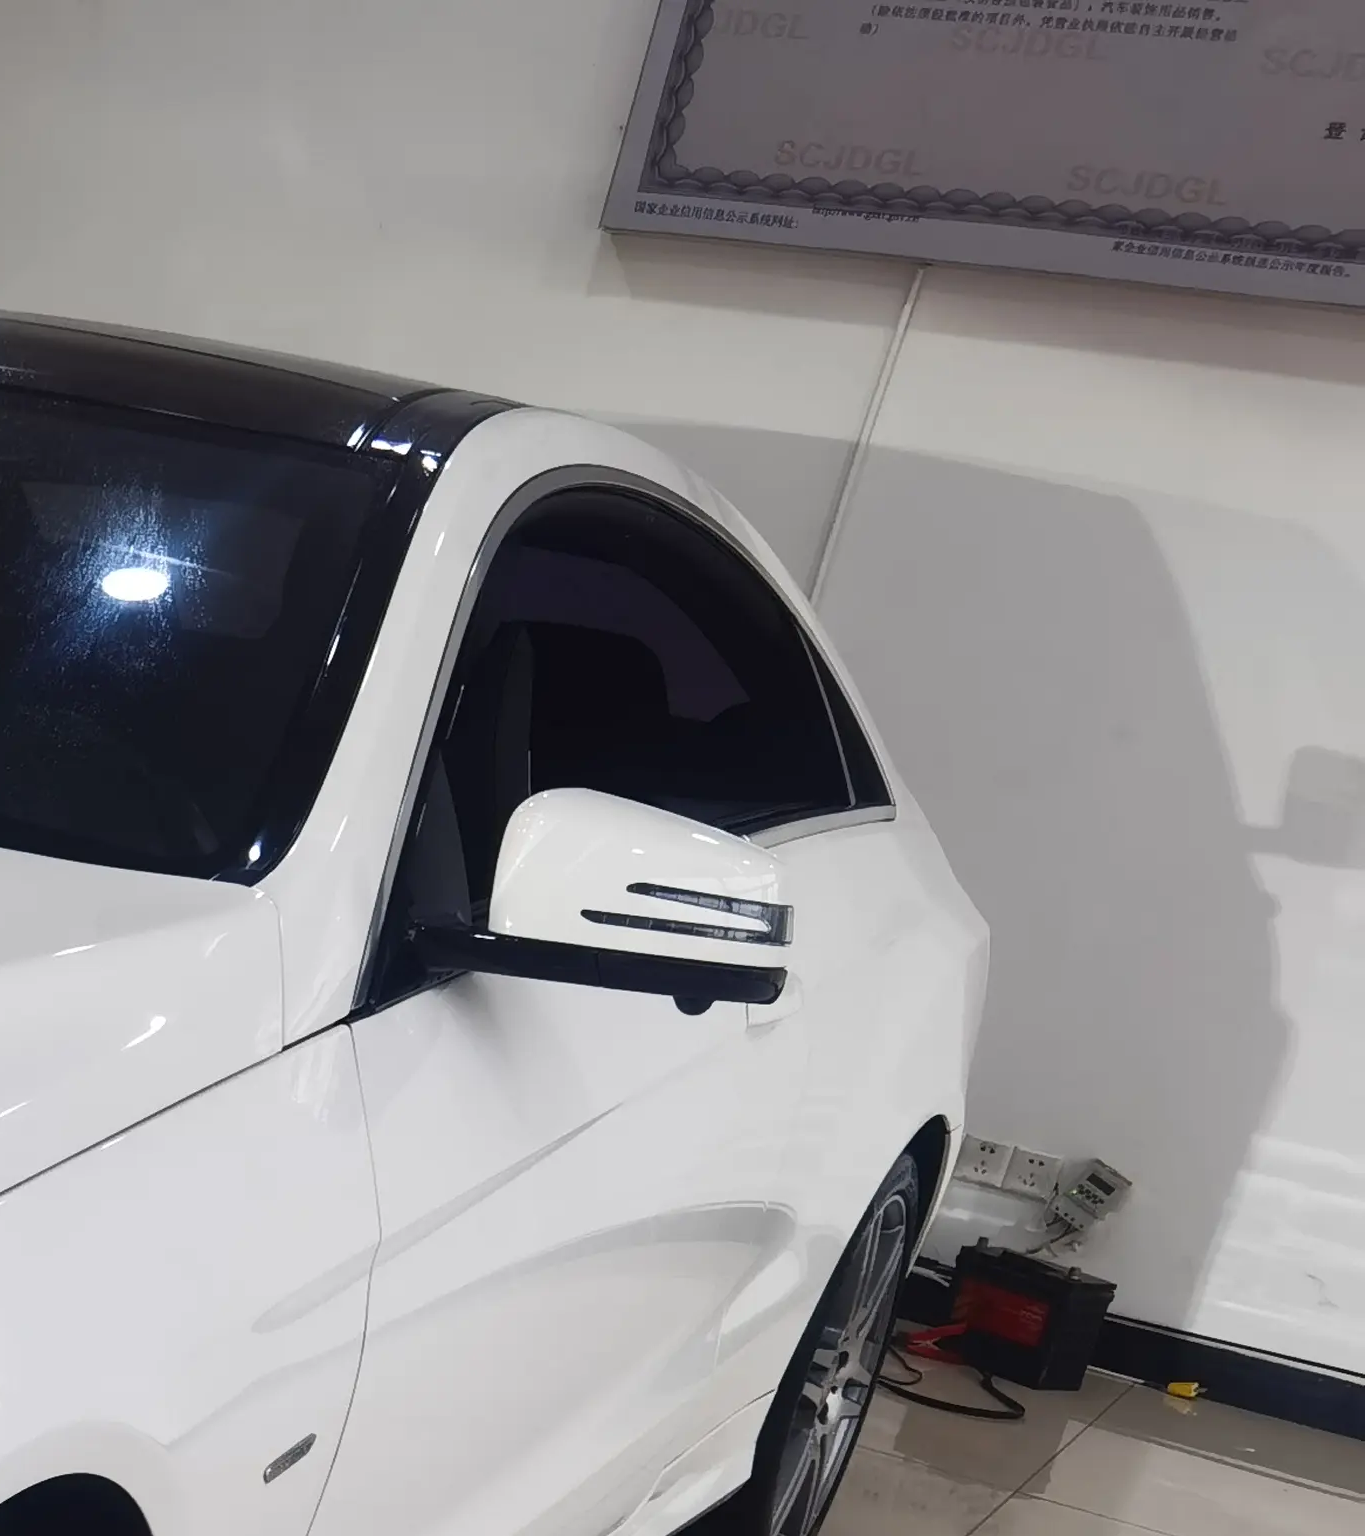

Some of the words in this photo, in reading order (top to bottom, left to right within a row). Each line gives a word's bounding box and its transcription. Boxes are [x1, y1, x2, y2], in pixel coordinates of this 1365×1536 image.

[951, 23, 1107, 60] SCJDGL
[774, 139, 923, 176] SCJDGL
[1066, 164, 1227, 206] SCJDGL
